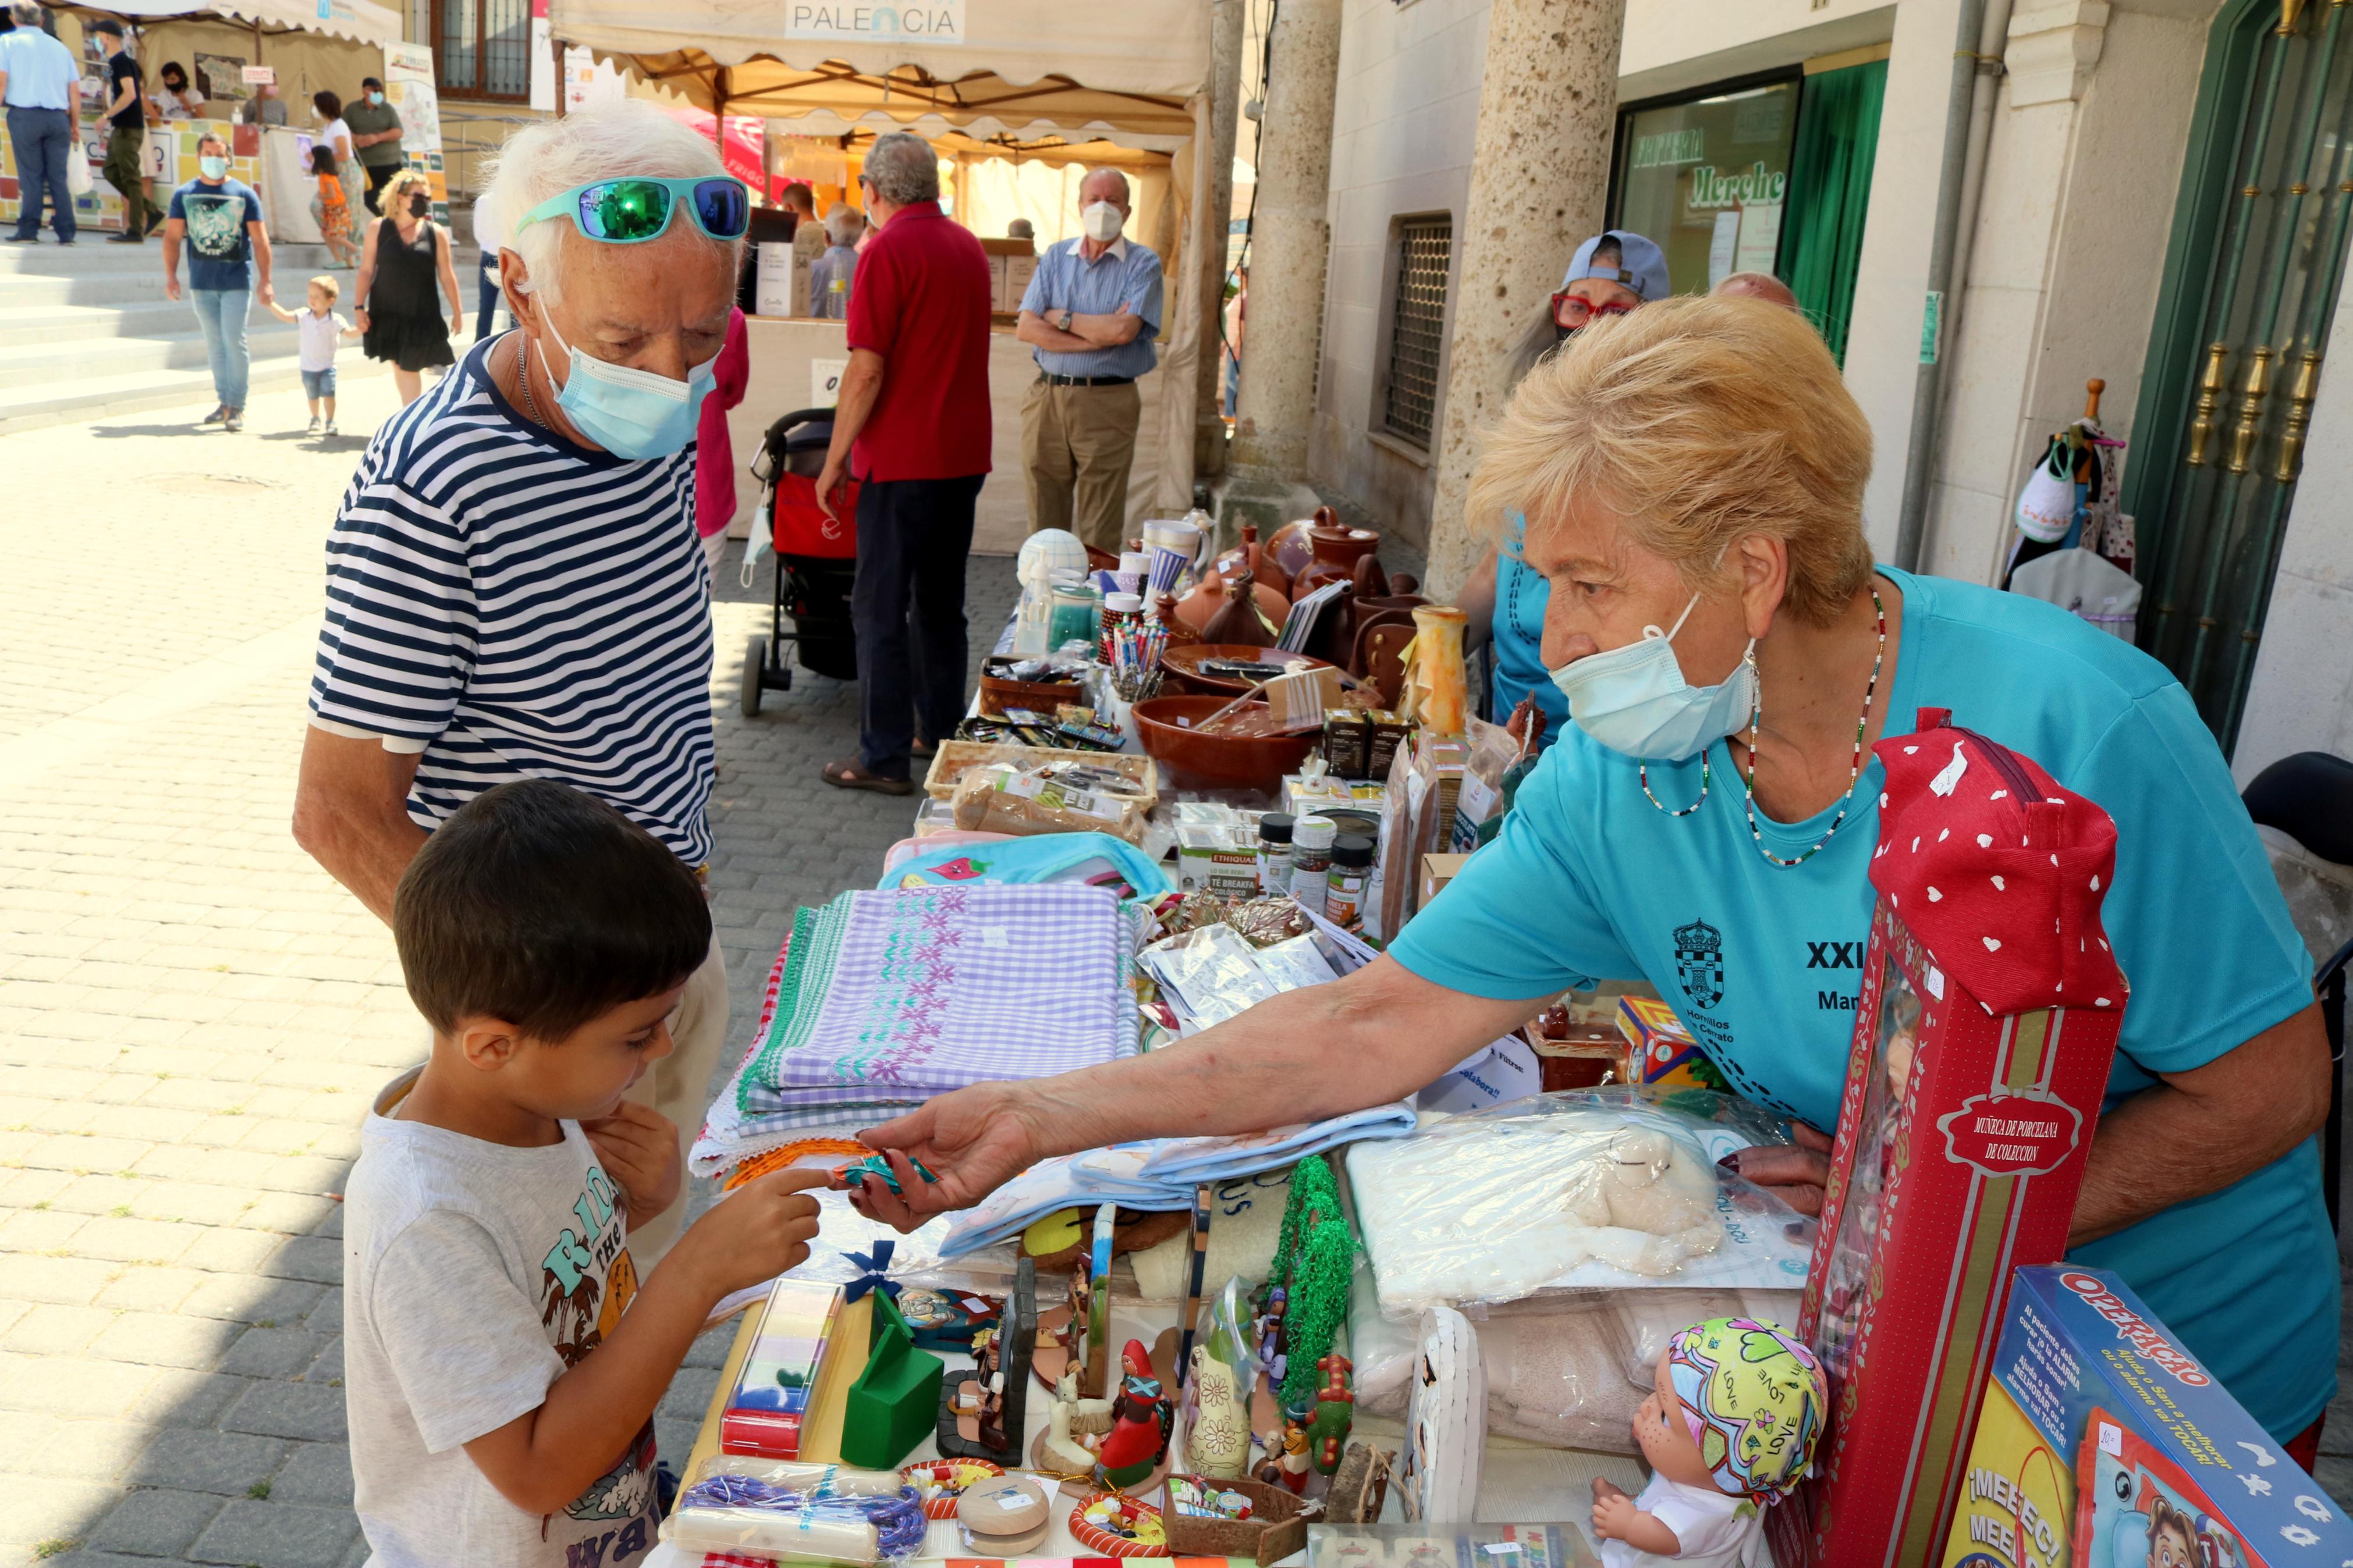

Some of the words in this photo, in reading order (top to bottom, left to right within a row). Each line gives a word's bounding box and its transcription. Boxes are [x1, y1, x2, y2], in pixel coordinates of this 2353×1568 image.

[1690, 161, 1786, 208] Merche
[1686, 1008, 1730, 1030] Hornillos
[1699, 1024, 1734, 1043] Cerrato
[1974, 1115, 2006, 1135] MUÑECA
[2004, 1119, 2018, 1136] DE
[2016, 1121, 2059, 1138] PORCELANA
[1985, 1143, 1996, 1160] DE
[1997, 1144, 2039, 1162] COLECCION
[2020, 1316, 2038, 1339] curar
[2045, 1345, 2052, 1359] la
[2052, 1354, 2081, 1392] ALARMA
[2024, 1304, 2031, 1317] Al
[2032, 1314, 2060, 1350] paciente
[2060, 1347, 2081, 1375] debes
[2059, 1272, 2210, 1387] OPERAÇÃO
[1723, 1370, 1738, 1411] LOVE
[1757, 1368, 1786, 1405] LOVE
[2018, 1354, 2037, 1381] Ajuda
[2038, 1379, 2043, 1388] o
[2044, 1383, 2060, 1408] Sam
[2060, 1406, 2065, 1415] a
[2027, 1338, 2045, 1364] harás
[2046, 1362, 2067, 1391] sonar!
[2007, 1373, 2030, 1404] alarme
[2031, 1400, 2041, 1416] vai
[2041, 1410, 2067, 1448] TOCAR!
[2013, 1363, 2050, 1413] MELHORAR
[2050, 1409, 2059, 1424] ou
[2060, 1421, 2065, 1431] o
[2101, 1349, 2117, 1361] ou
[2120, 1370, 2156, 1406] alarme
[2153, 1408, 2175, 1423] vai
[2169, 1424, 2213, 1467] TOCAR!
[2116, 1348, 2146, 1376] Ajuda
[2150, 1386, 2177, 1410] Sam
[2173, 1410, 2185, 1418] a
[2181, 1420, 2233, 1470] melhorar
[1766, 1416, 1798, 1455] LOVE
[1969, 1467, 2061, 1566] ¡MEEEC!
